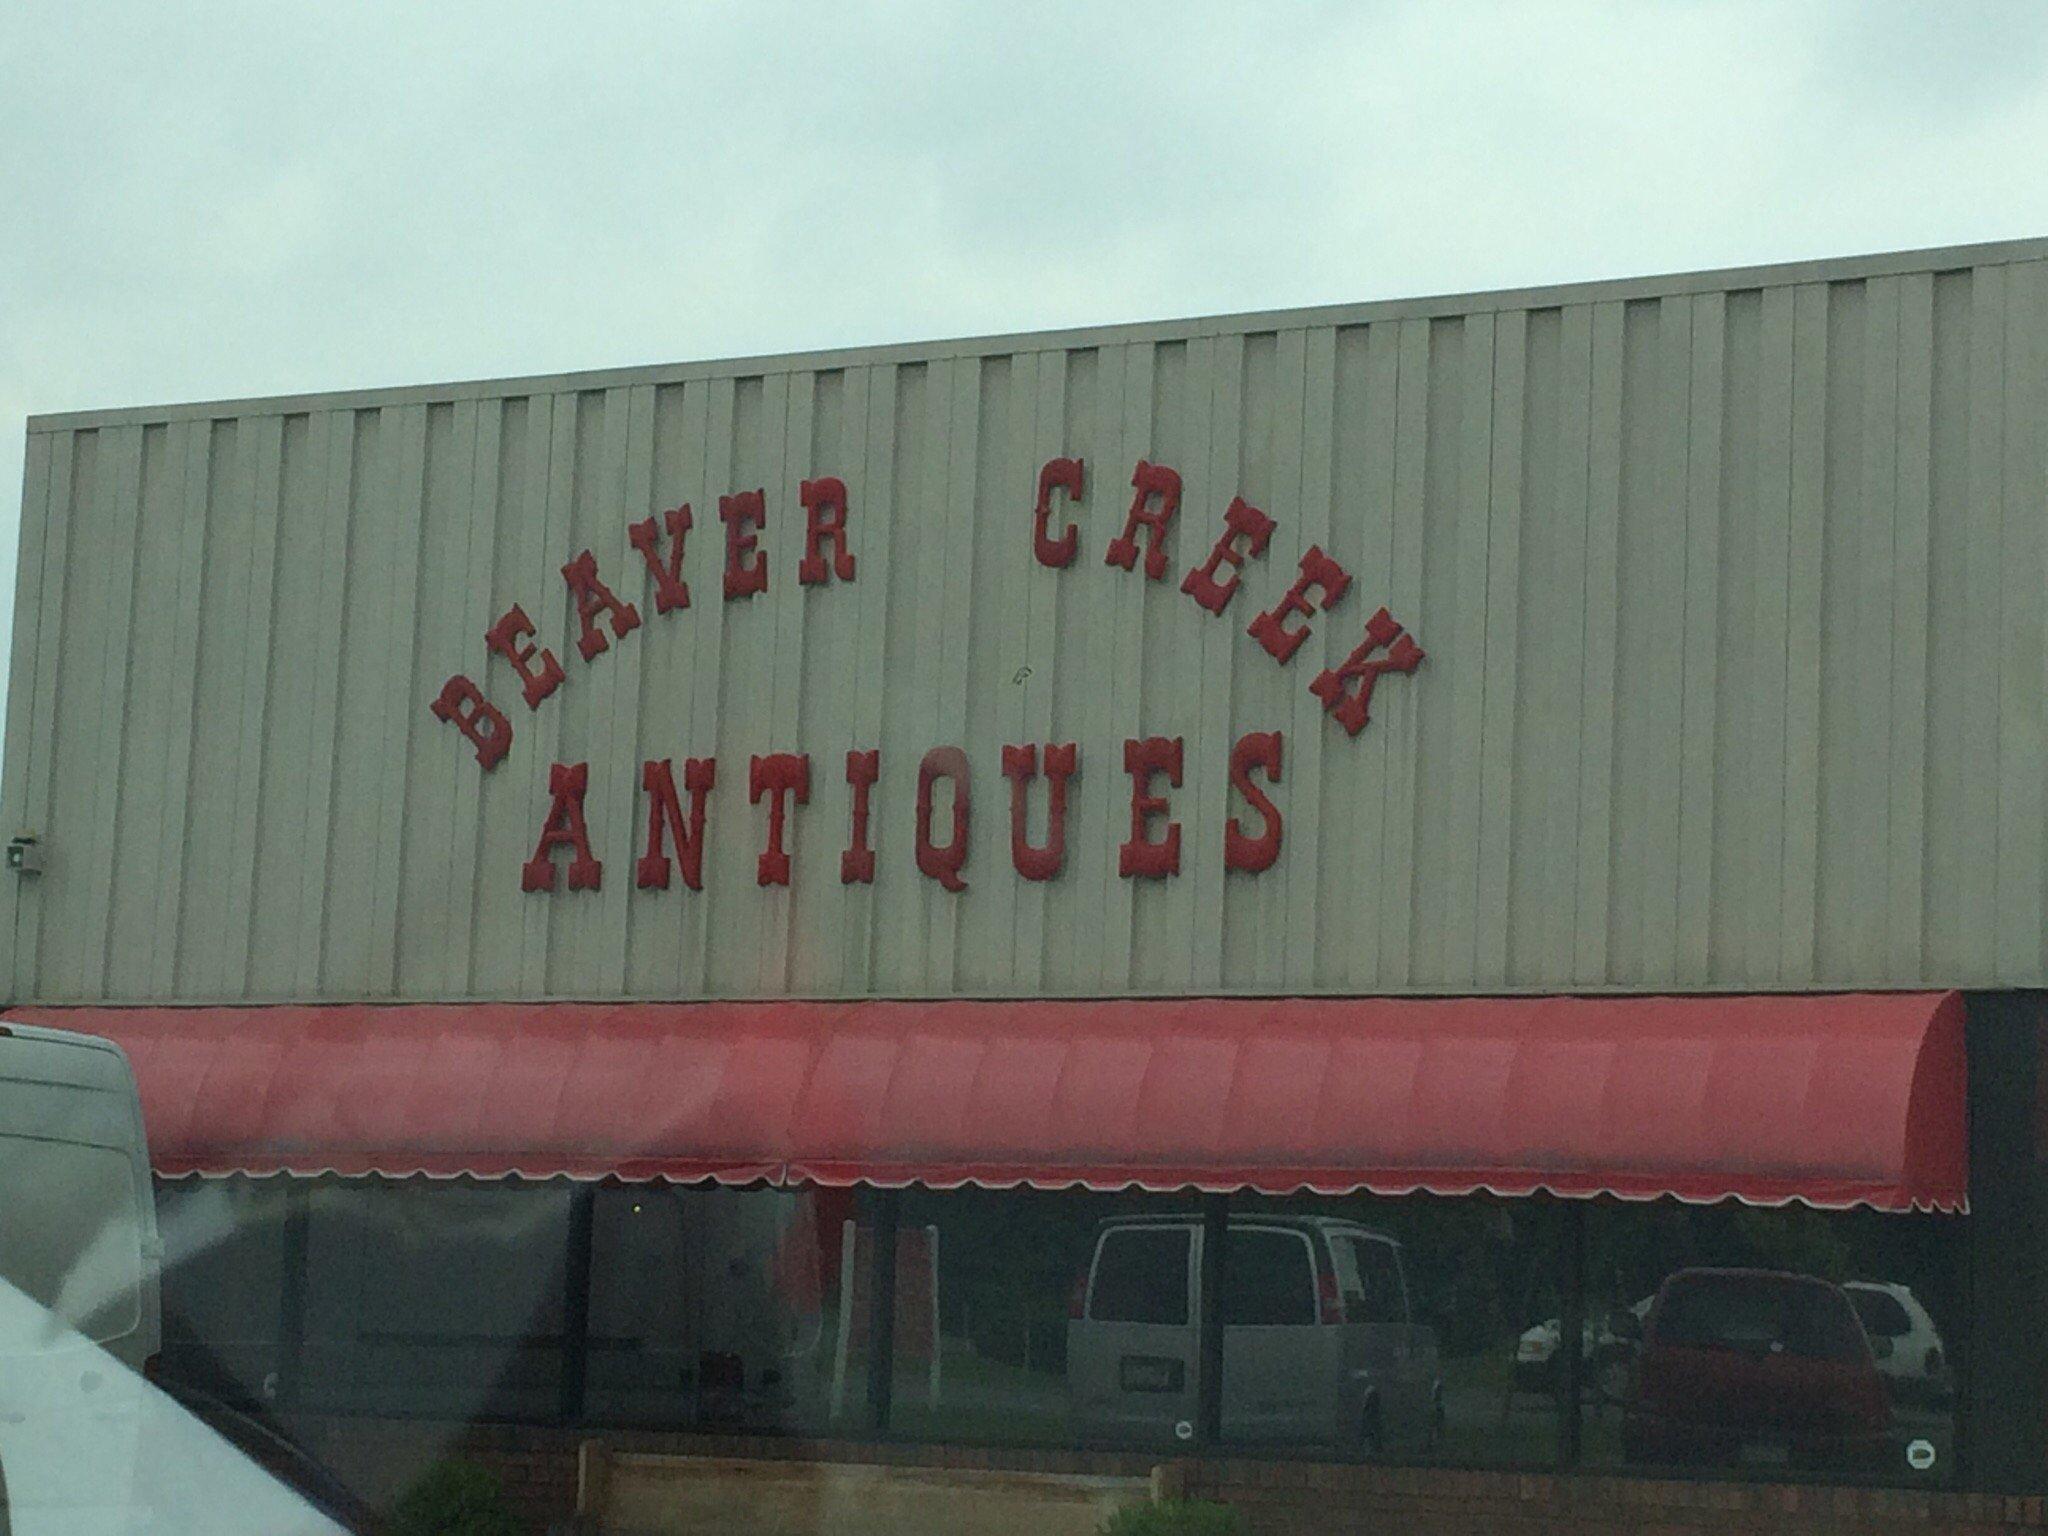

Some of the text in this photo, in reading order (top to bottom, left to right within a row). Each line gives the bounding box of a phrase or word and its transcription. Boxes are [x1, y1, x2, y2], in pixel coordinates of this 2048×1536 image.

[430, 458, 1425, 772] BEAVER CREEK
[521, 731, 1283, 892] ANTIQUES
